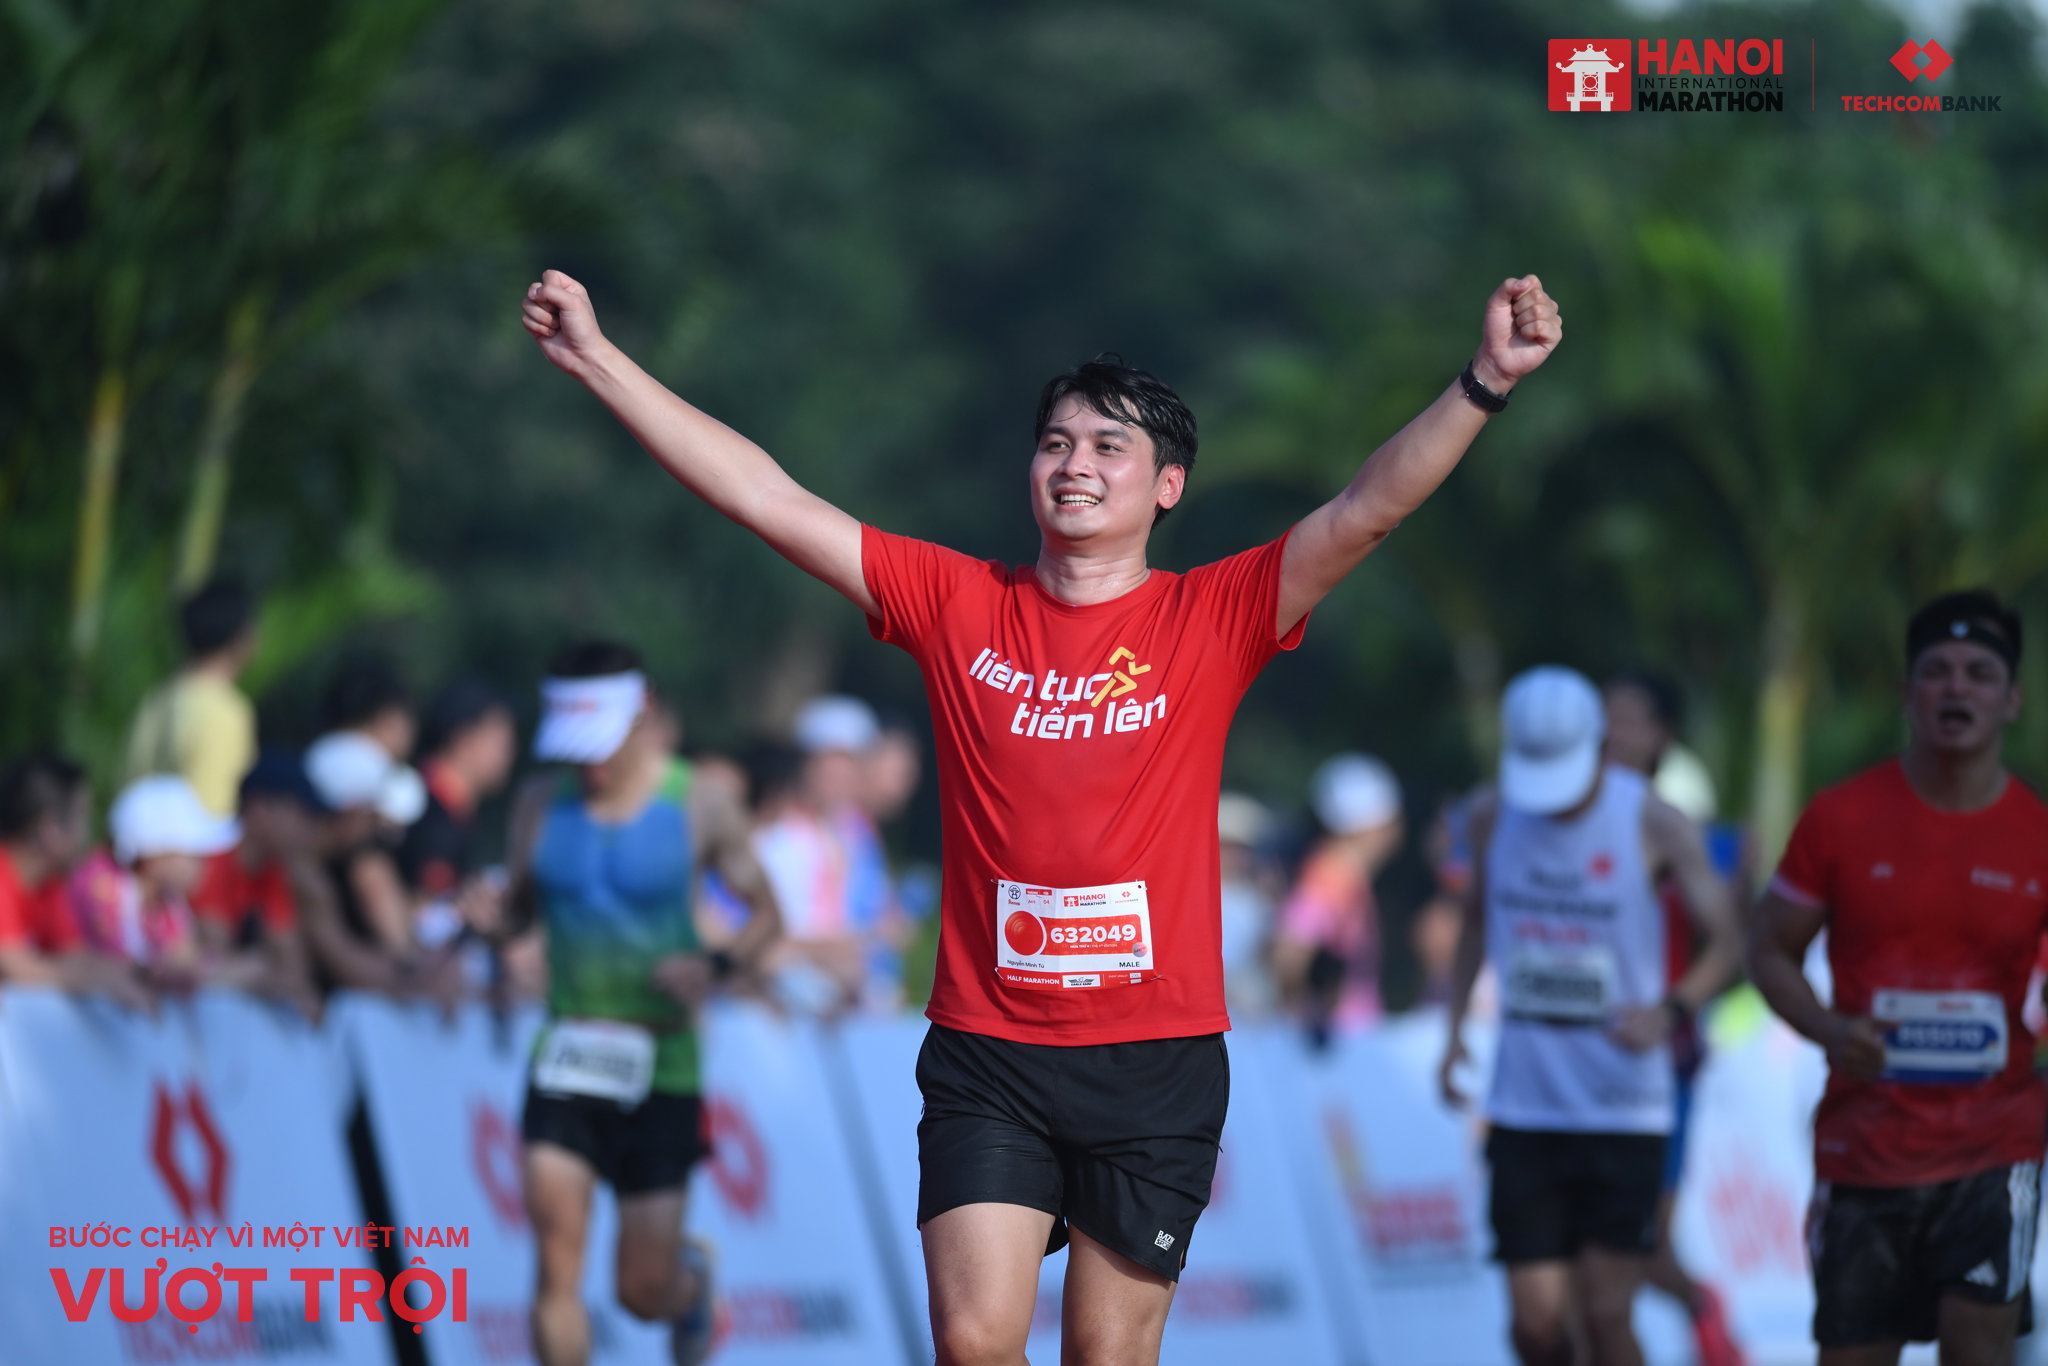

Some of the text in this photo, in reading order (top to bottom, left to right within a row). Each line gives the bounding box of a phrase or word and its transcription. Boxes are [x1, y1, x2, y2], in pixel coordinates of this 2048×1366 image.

[969, 648, 1113, 708] liên tục
[1010, 693, 1167, 740] tiến lên
[1079, 893, 1106, 901] HANOI
[1050, 924, 1137, 944] 632049
[1023, 977, 1060, 985] MARATHON
